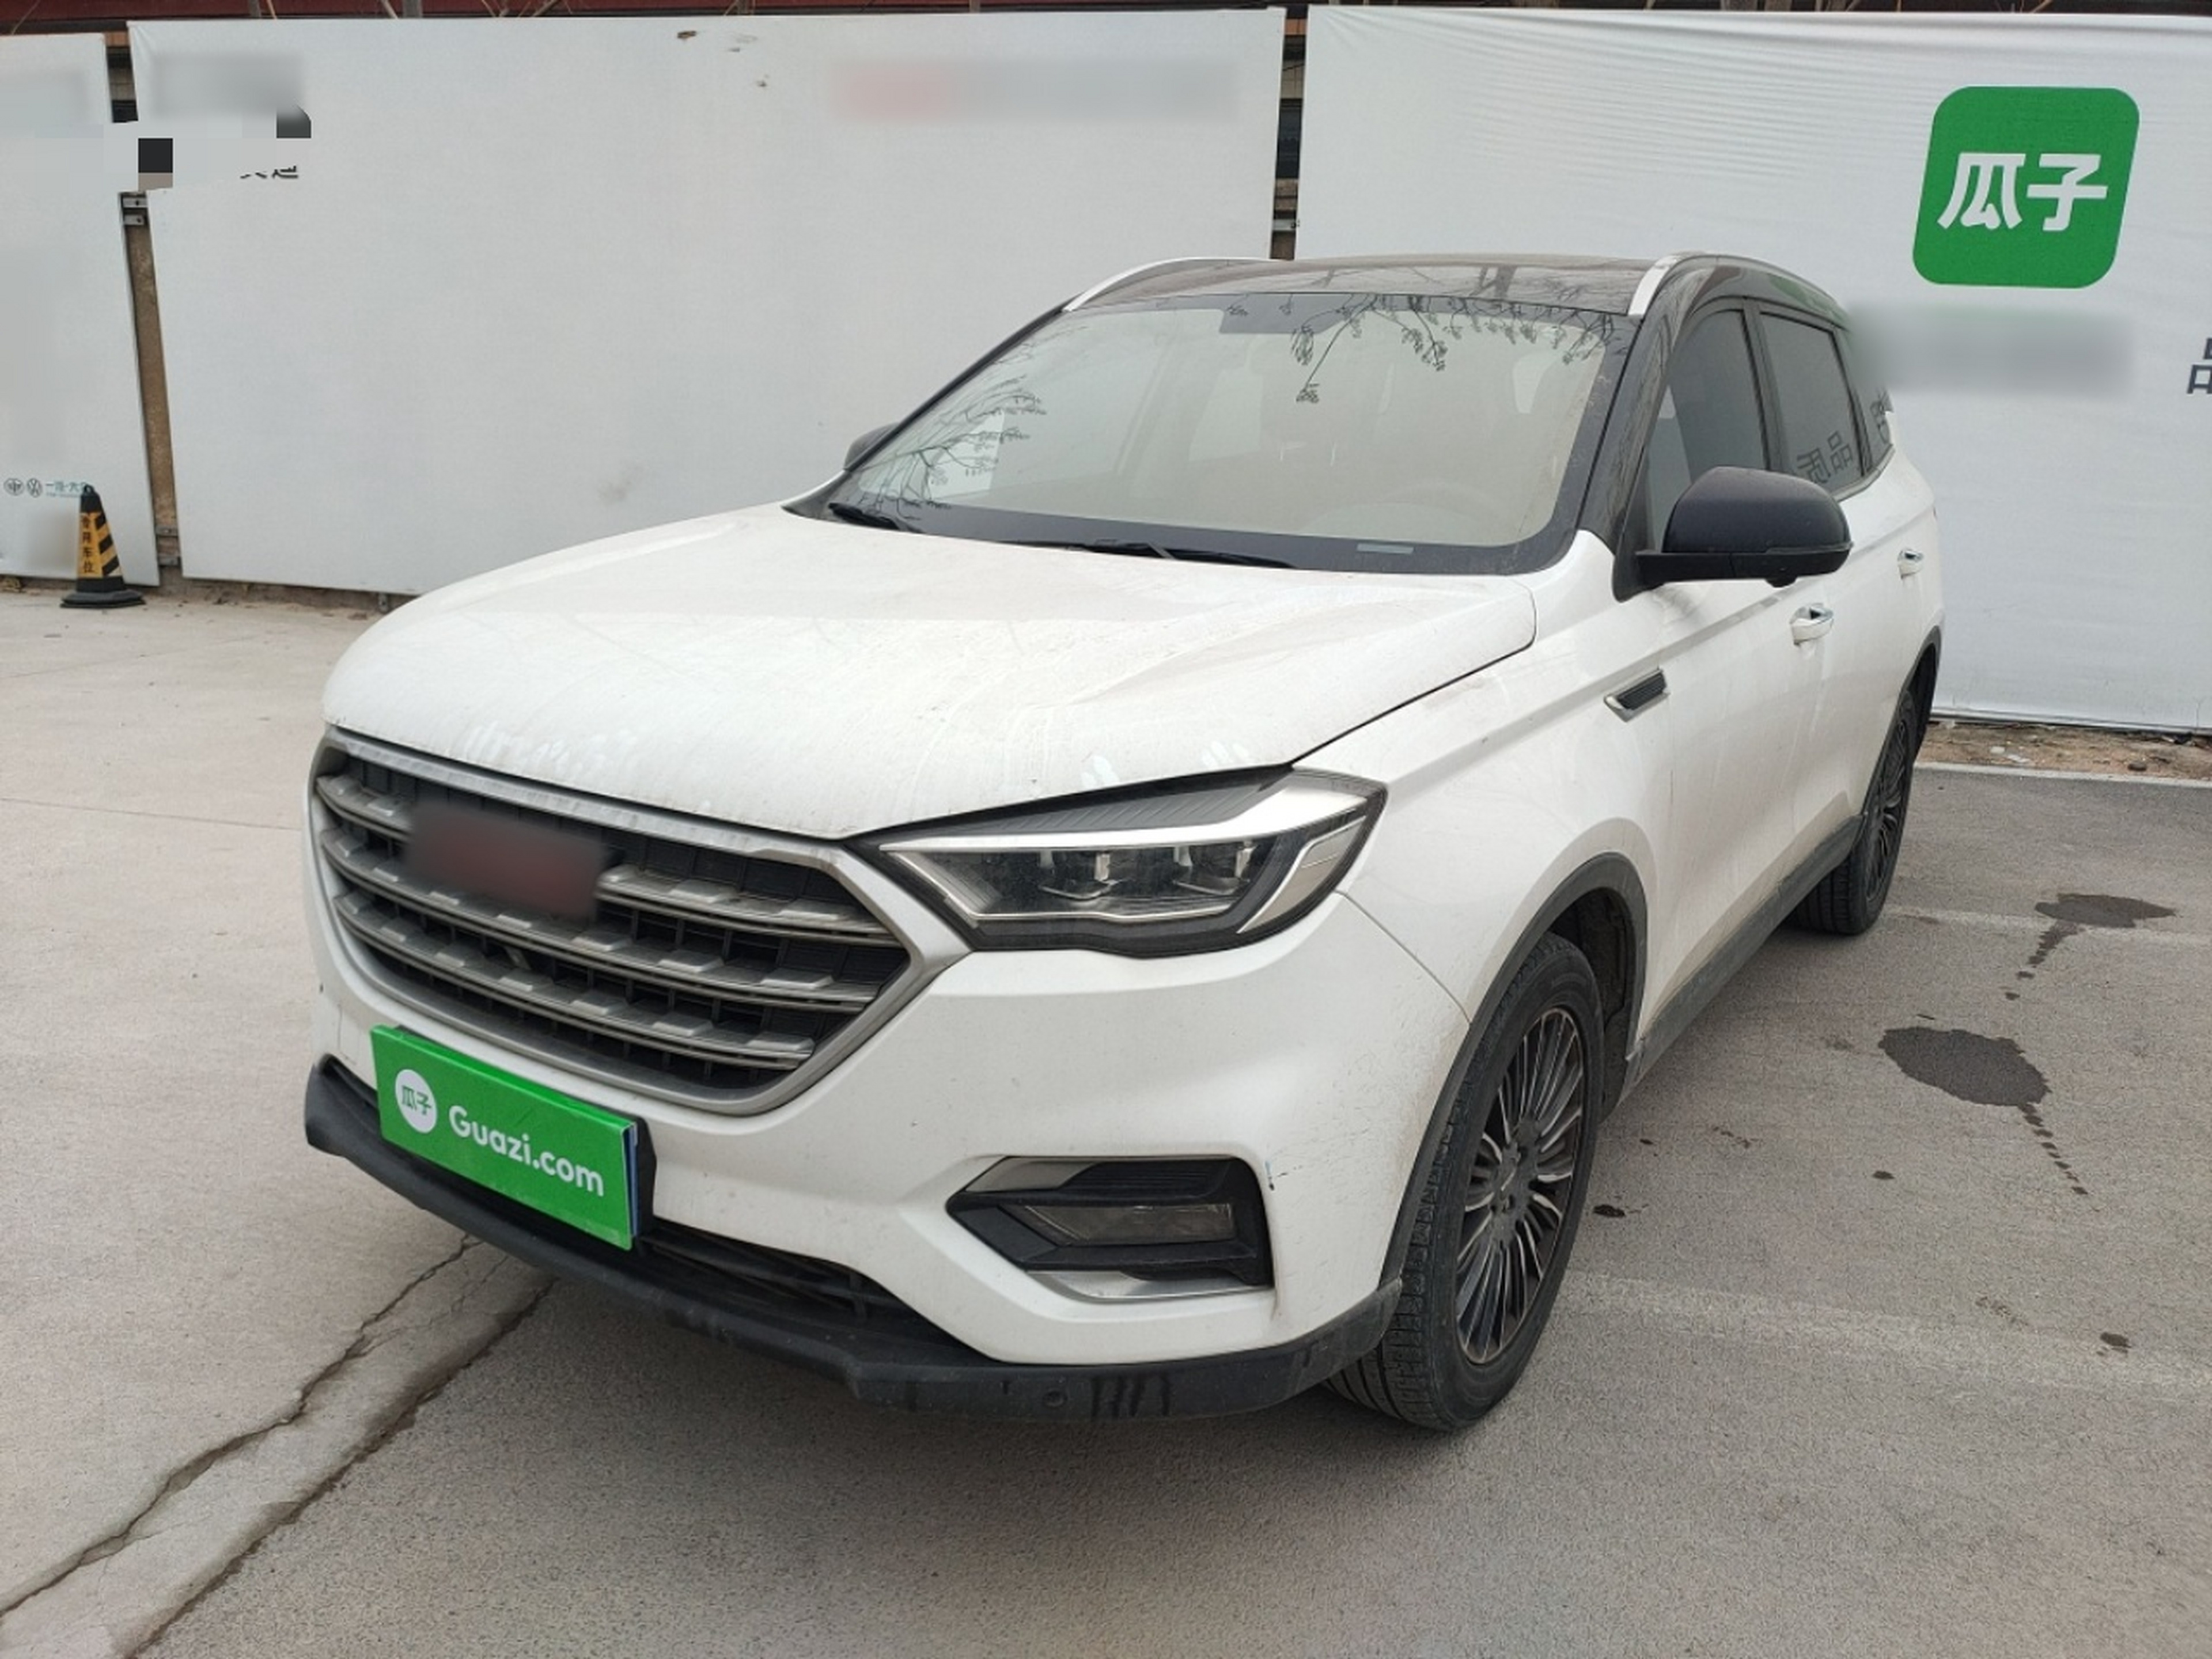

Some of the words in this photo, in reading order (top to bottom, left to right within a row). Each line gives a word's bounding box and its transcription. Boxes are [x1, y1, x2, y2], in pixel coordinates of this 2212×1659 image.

[1937, 152, 2108, 232] 瓜子
[401, 1085, 433, 1115] 瓜子
[449, 1105, 604, 1196] Guazi.com
